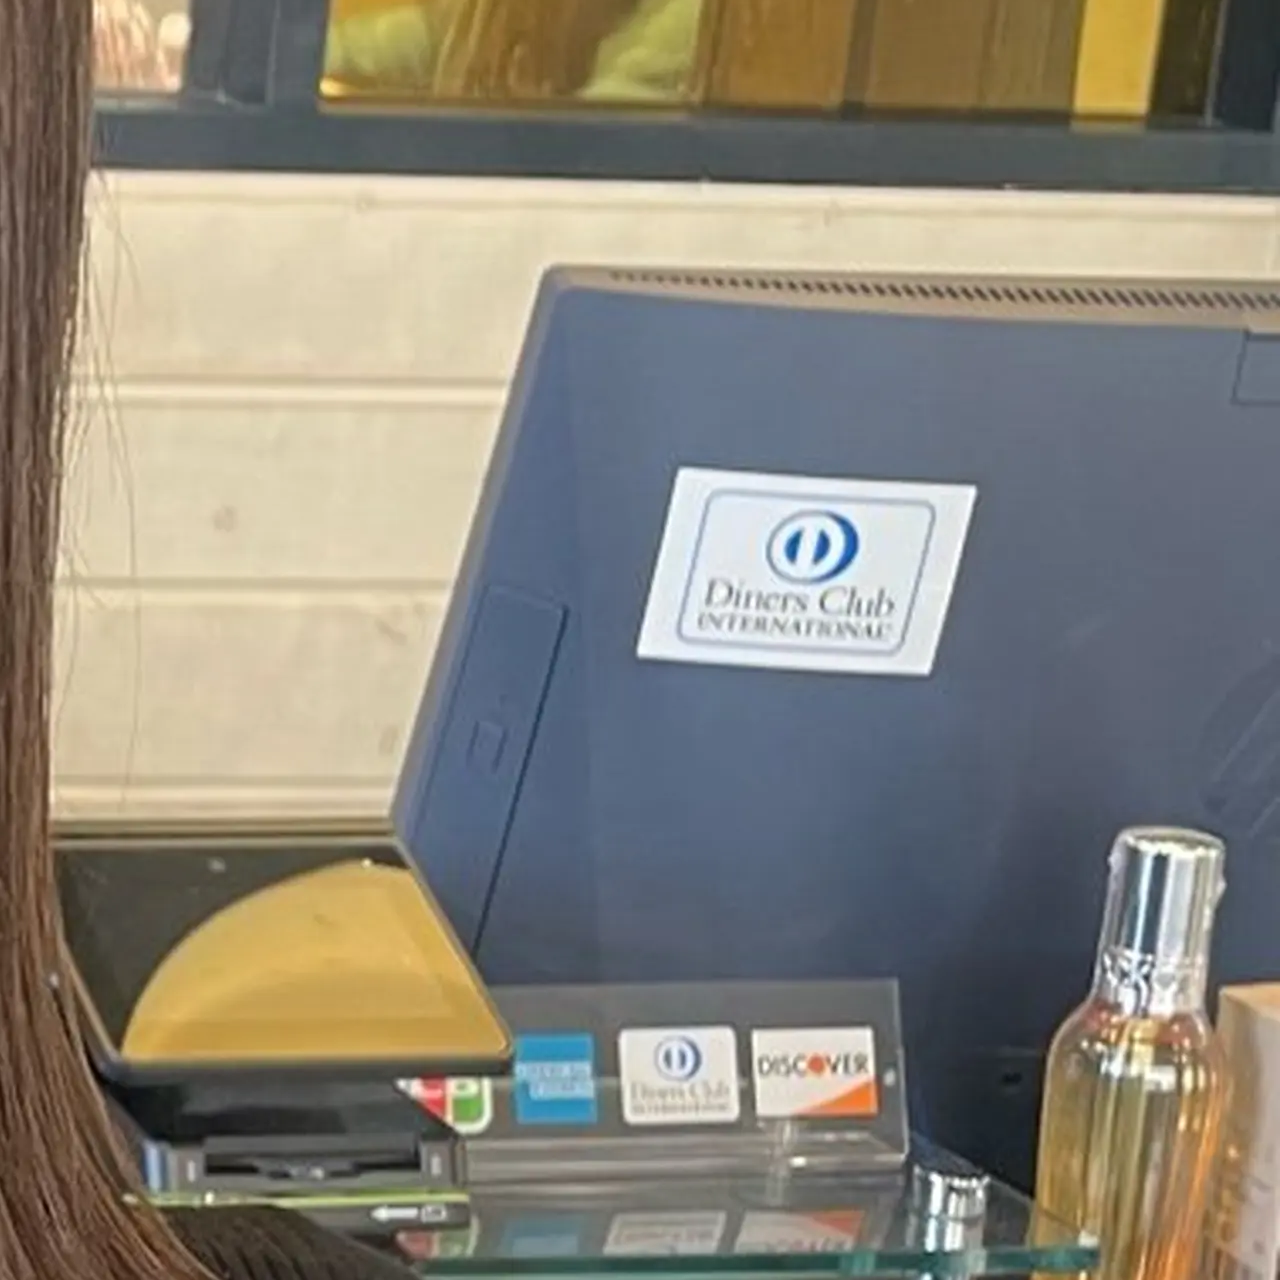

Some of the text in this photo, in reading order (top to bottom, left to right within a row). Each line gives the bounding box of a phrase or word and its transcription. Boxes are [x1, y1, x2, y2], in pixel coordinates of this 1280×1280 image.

[704, 577, 896, 618] Diners Club
[697, 611, 893, 641] INTERNATIONAL
[757, 1051, 871, 1078] DISCOVER
